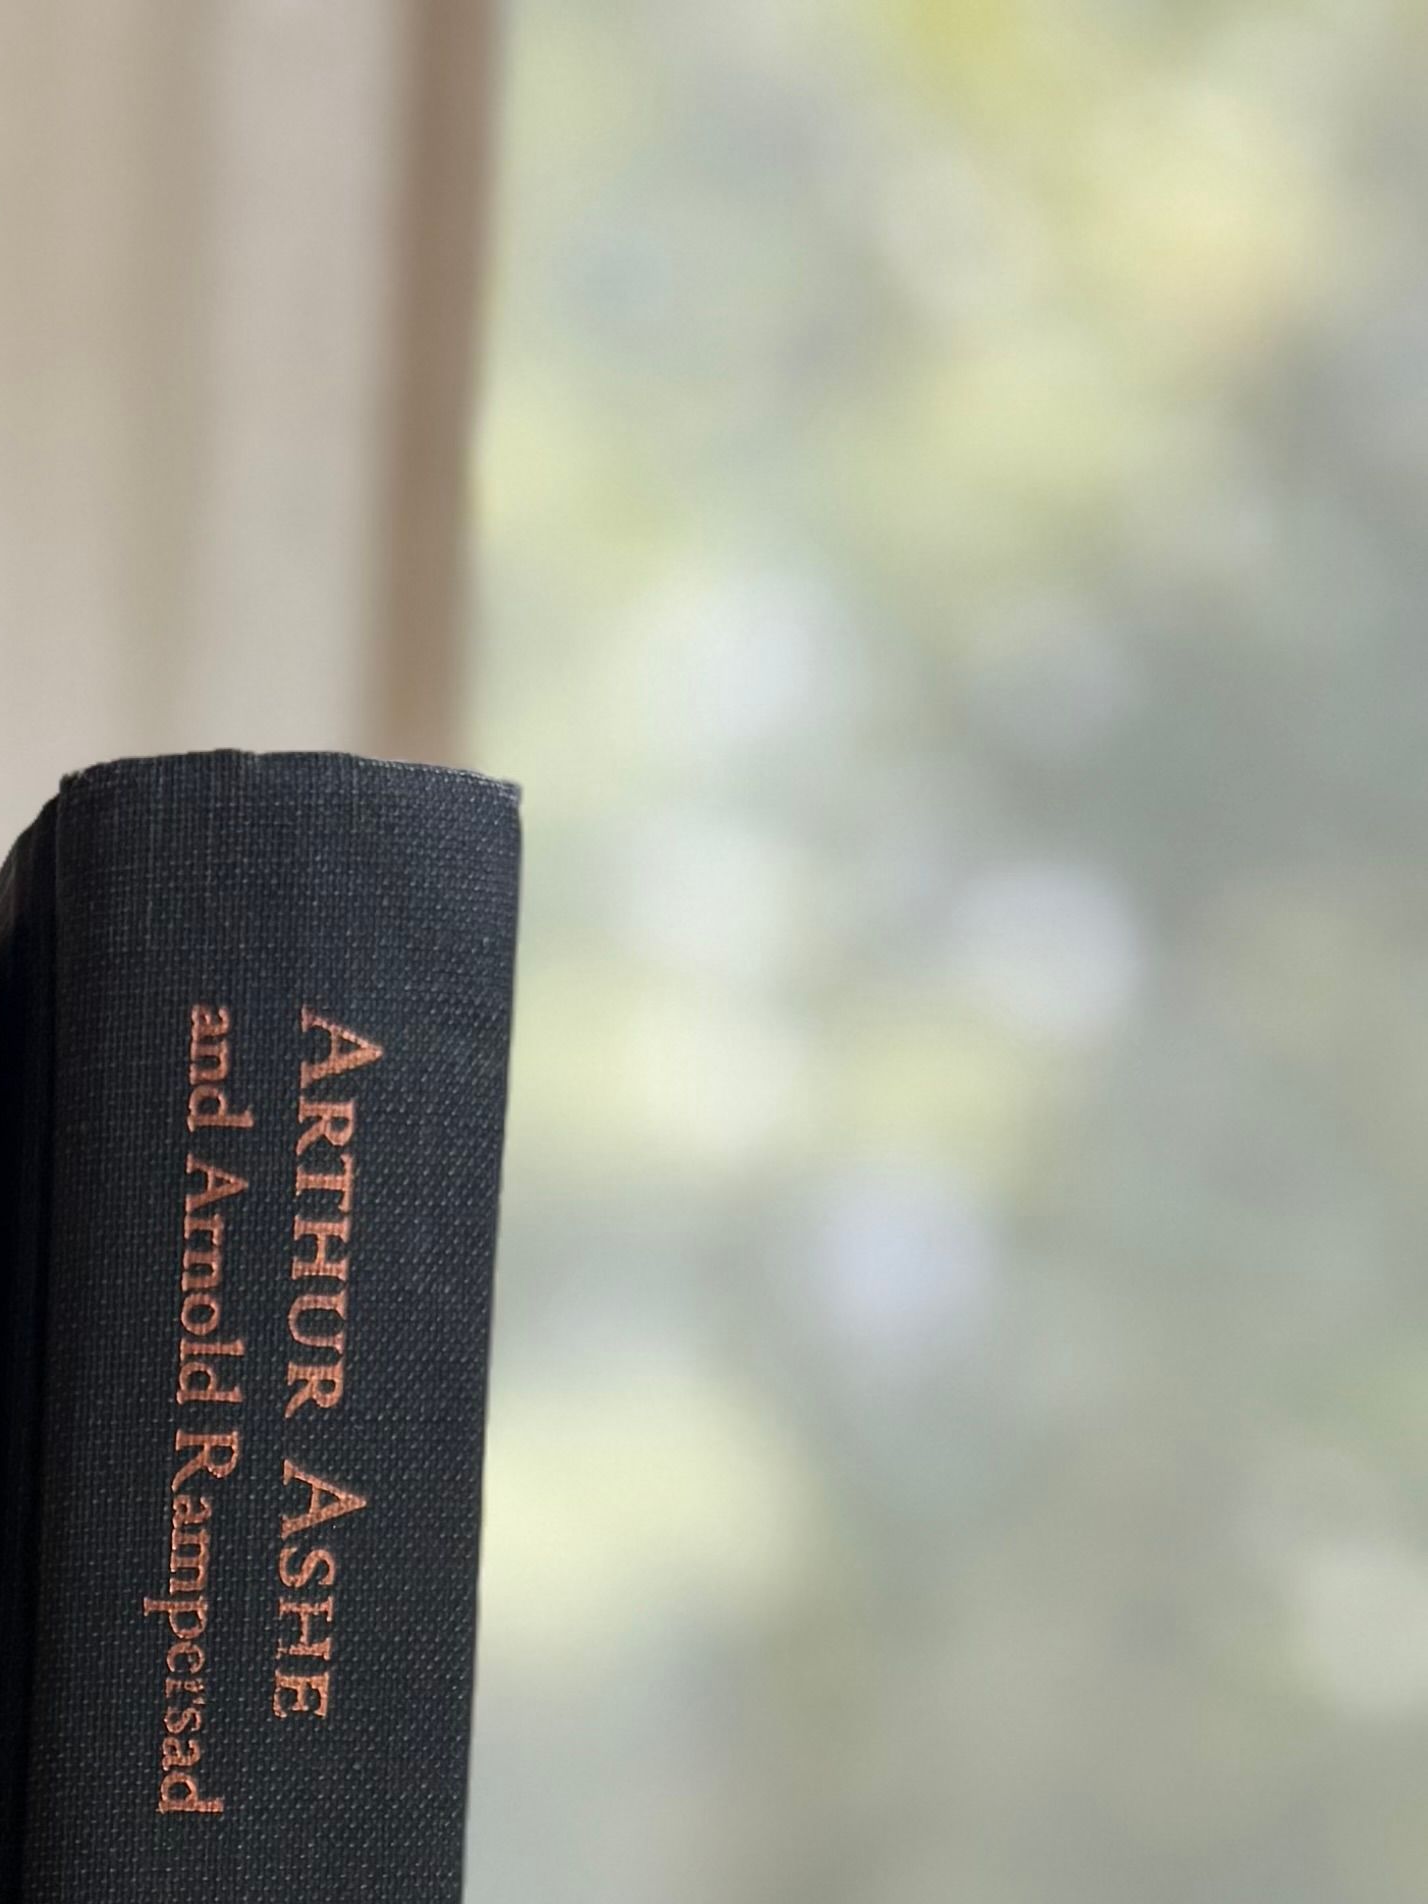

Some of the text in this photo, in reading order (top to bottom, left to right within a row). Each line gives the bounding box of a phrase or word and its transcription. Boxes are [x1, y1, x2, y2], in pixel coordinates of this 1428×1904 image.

[143, 1005, 255, 1814] and Arnold Rampersad
[273, 1009, 384, 1718] ARTHUR ASHE
